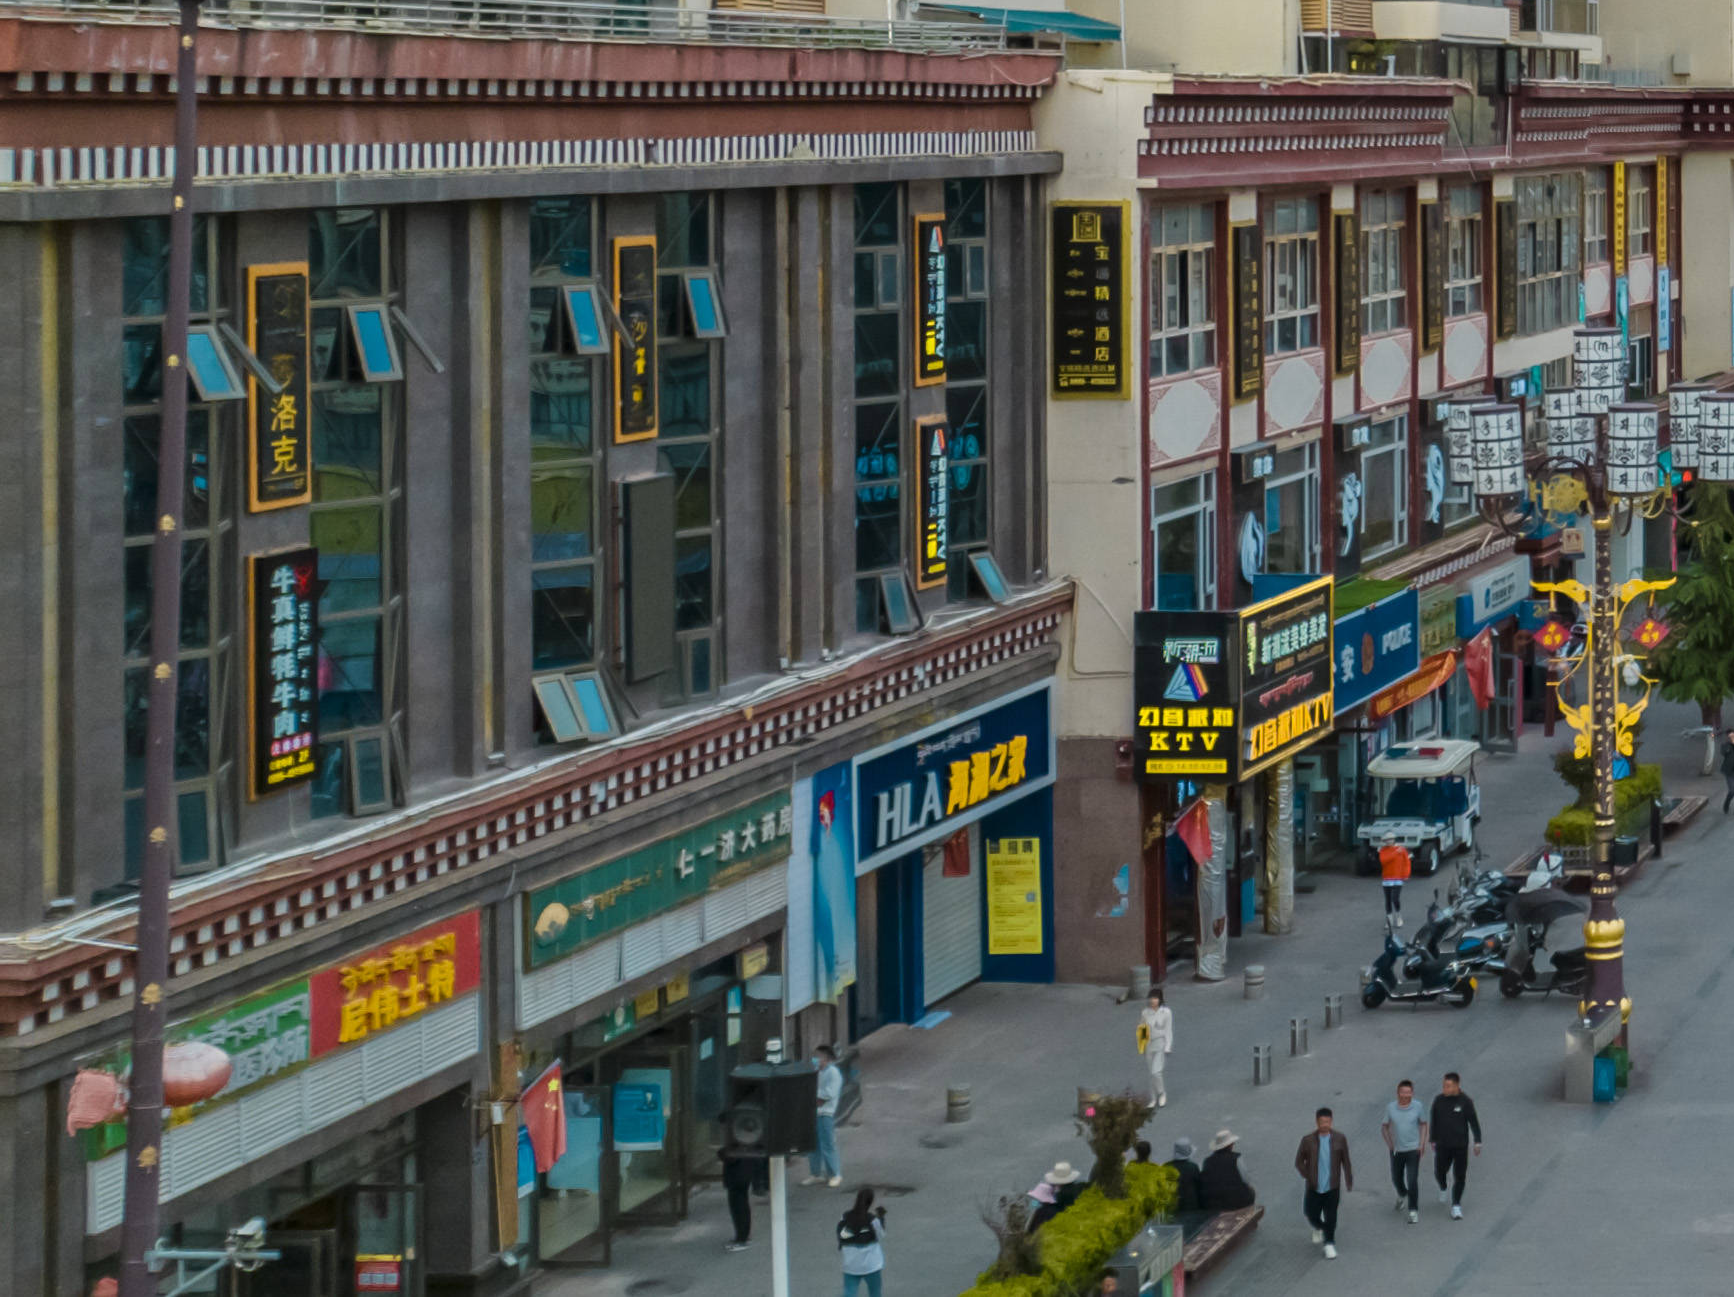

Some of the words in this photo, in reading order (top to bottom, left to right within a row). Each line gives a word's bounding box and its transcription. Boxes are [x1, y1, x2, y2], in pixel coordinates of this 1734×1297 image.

[1381, 621, 1413, 655] POLICE
[945, 734, 1029, 816] 海澜之家
[1149, 732, 1221, 751] KTV
[677, 805, 792, 879] 仁一济大药房
[875, 770, 943, 849] HLA
